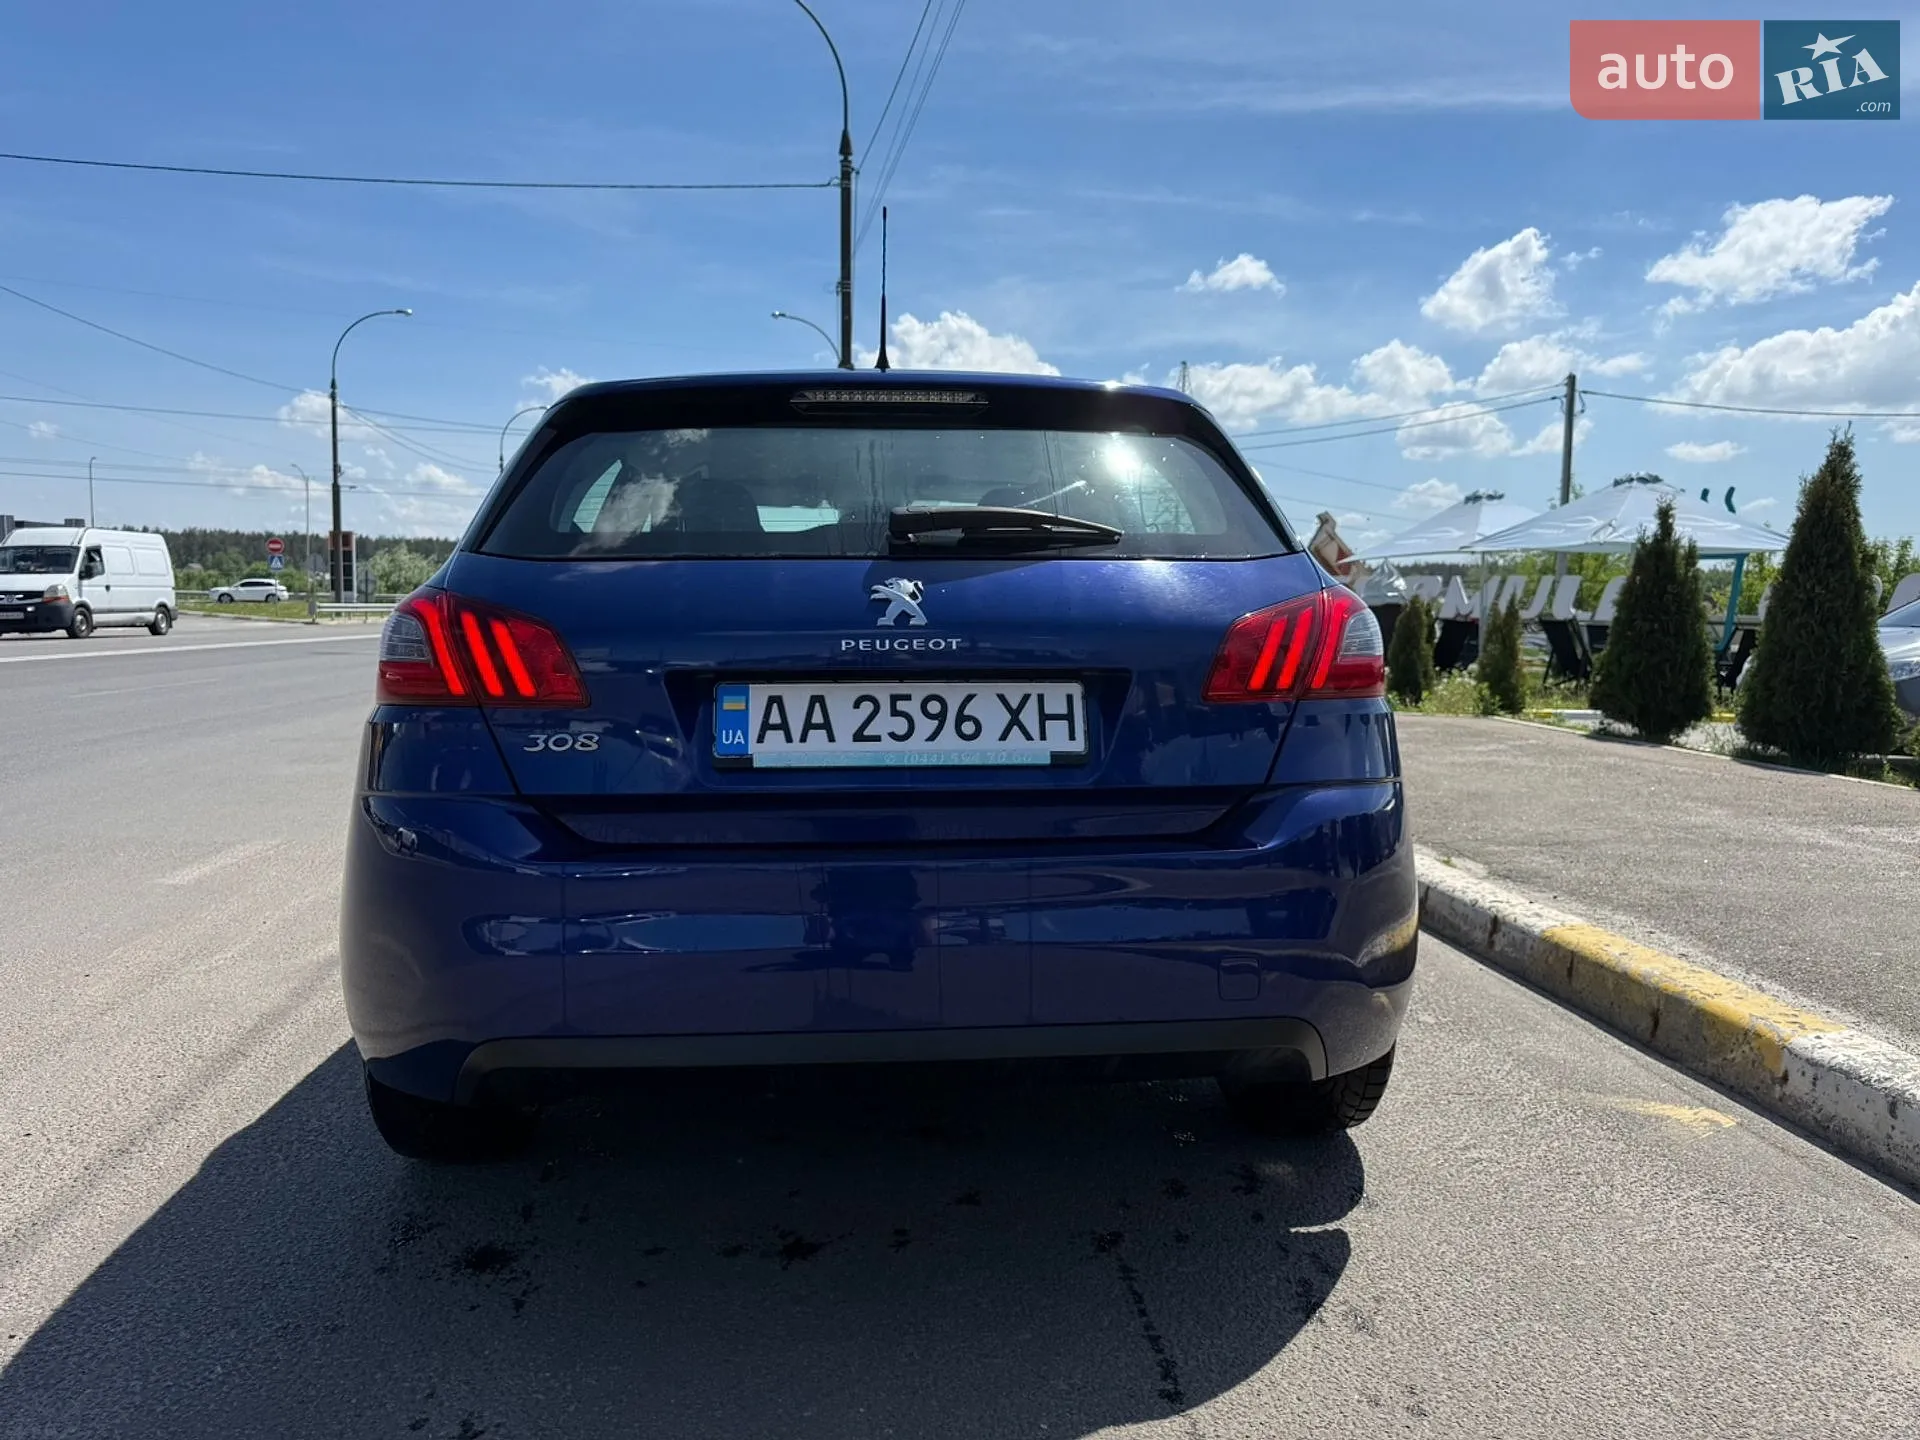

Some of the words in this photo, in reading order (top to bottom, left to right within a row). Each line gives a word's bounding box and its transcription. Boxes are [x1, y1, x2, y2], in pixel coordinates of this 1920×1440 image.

[841, 638, 961, 651] PEUGEOT
[756, 694, 836, 744] AA
[851, 693, 983, 743] 2596
[996, 692, 1076, 742] XH
[523, 733, 600, 752] 308
[722, 730, 746, 744] UA
